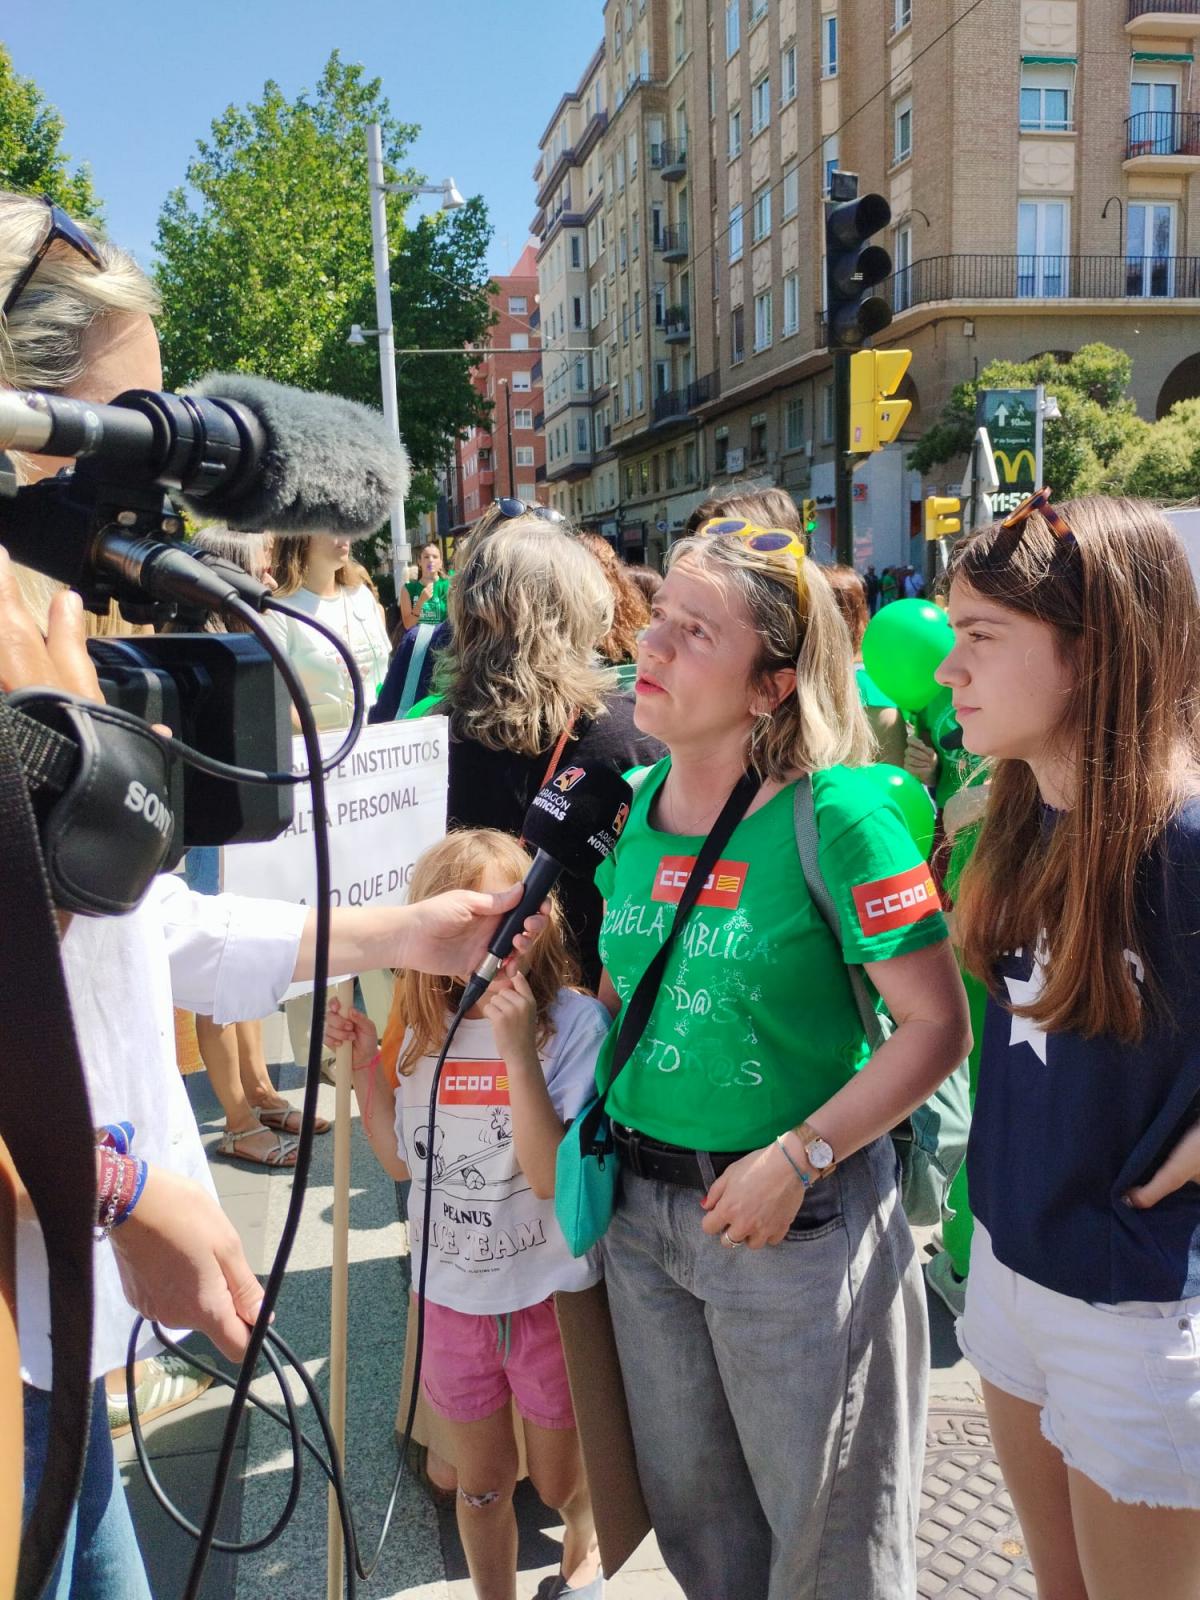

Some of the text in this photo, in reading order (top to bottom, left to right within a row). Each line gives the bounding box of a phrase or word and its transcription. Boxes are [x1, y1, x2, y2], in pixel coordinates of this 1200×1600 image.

[351, 738, 440, 777] INSTITUTOS
[337, 786, 419, 826] PERSONAL
[532, 796, 567, 821] NOTICIAS
[539, 788, 571, 811] ARAGÓN
[348, 873, 384, 908] QUE
[659, 869, 715, 890] CCO
[865, 883, 928, 919] CCOO
[445, 1075, 493, 1091] CCOO
[443, 1201, 493, 1228] PEANUS
[464, 1219, 547, 1262] TEAM
